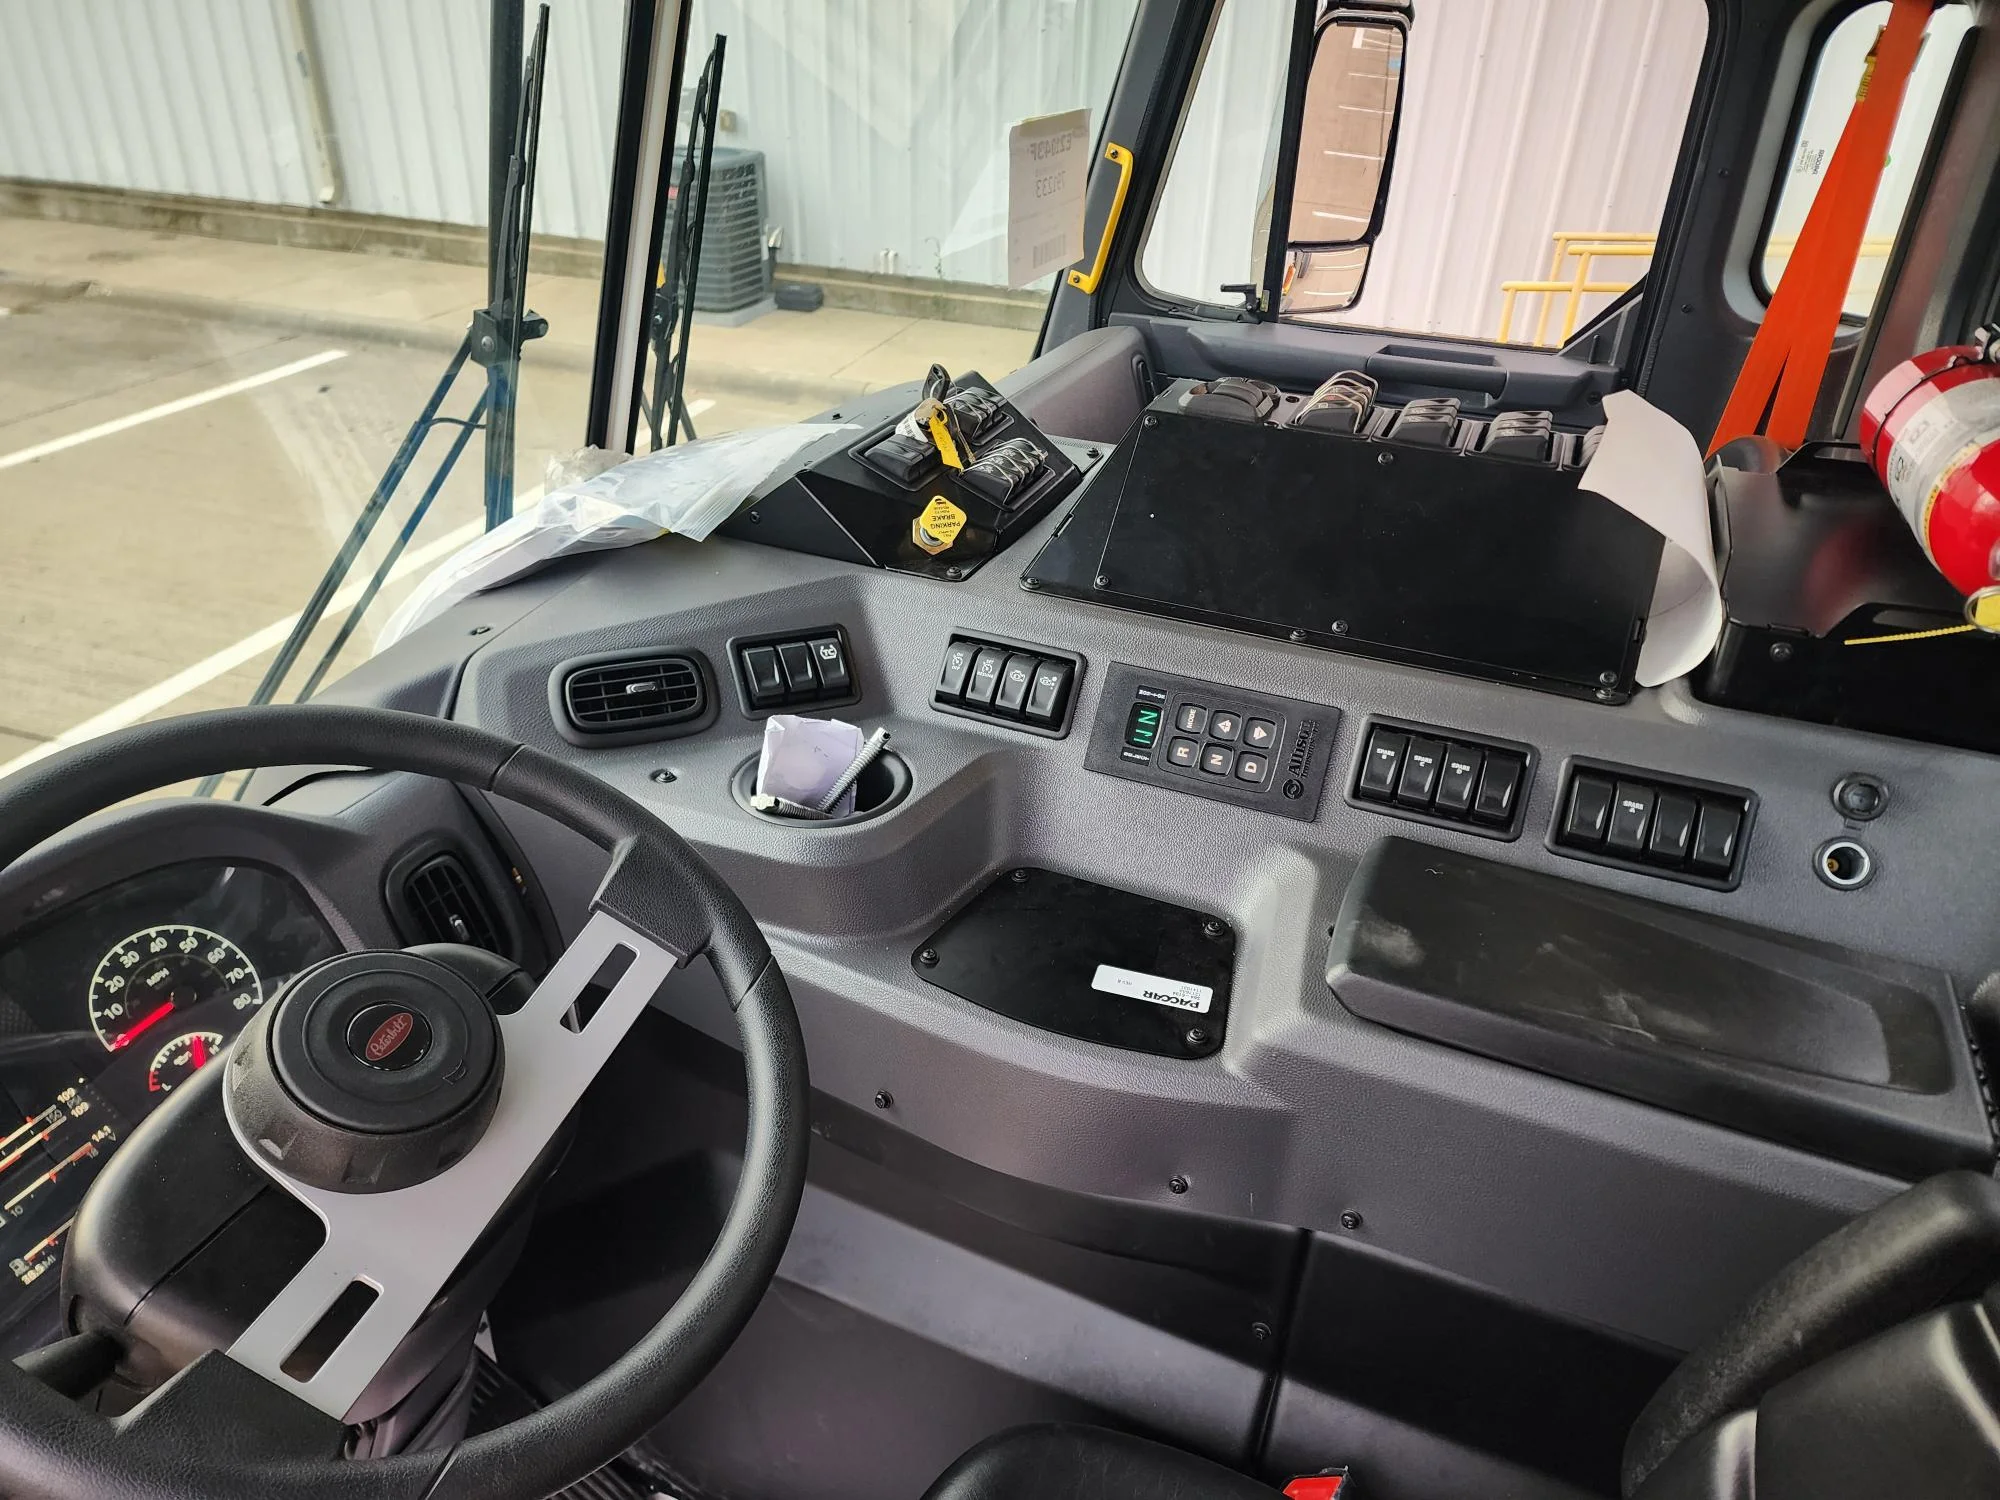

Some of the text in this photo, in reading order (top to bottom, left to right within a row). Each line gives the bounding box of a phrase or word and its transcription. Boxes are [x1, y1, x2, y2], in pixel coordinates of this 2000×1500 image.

[823, 648, 836, 657] TC
[1186, 707, 1197, 730] MODE
[1176, 745, 1190, 759] R
[1210, 753, 1224, 766] N
[1244, 761, 1258, 774] D
[149, 937, 167, 952] 40
[178, 937, 198, 953] 50
[119, 950, 139, 968] 30
[207, 949, 225, 964] 60
[146, 968, 170, 986] MPH
[225, 967, 244, 983] 70
[104, 975, 125, 993] 20
[232, 994, 251, 1009] 80
[1142, 990, 1200, 1009] PACCAR
[103, 1003, 123, 1019] 10
[370, 1015, 408, 1056] Peterbilt
